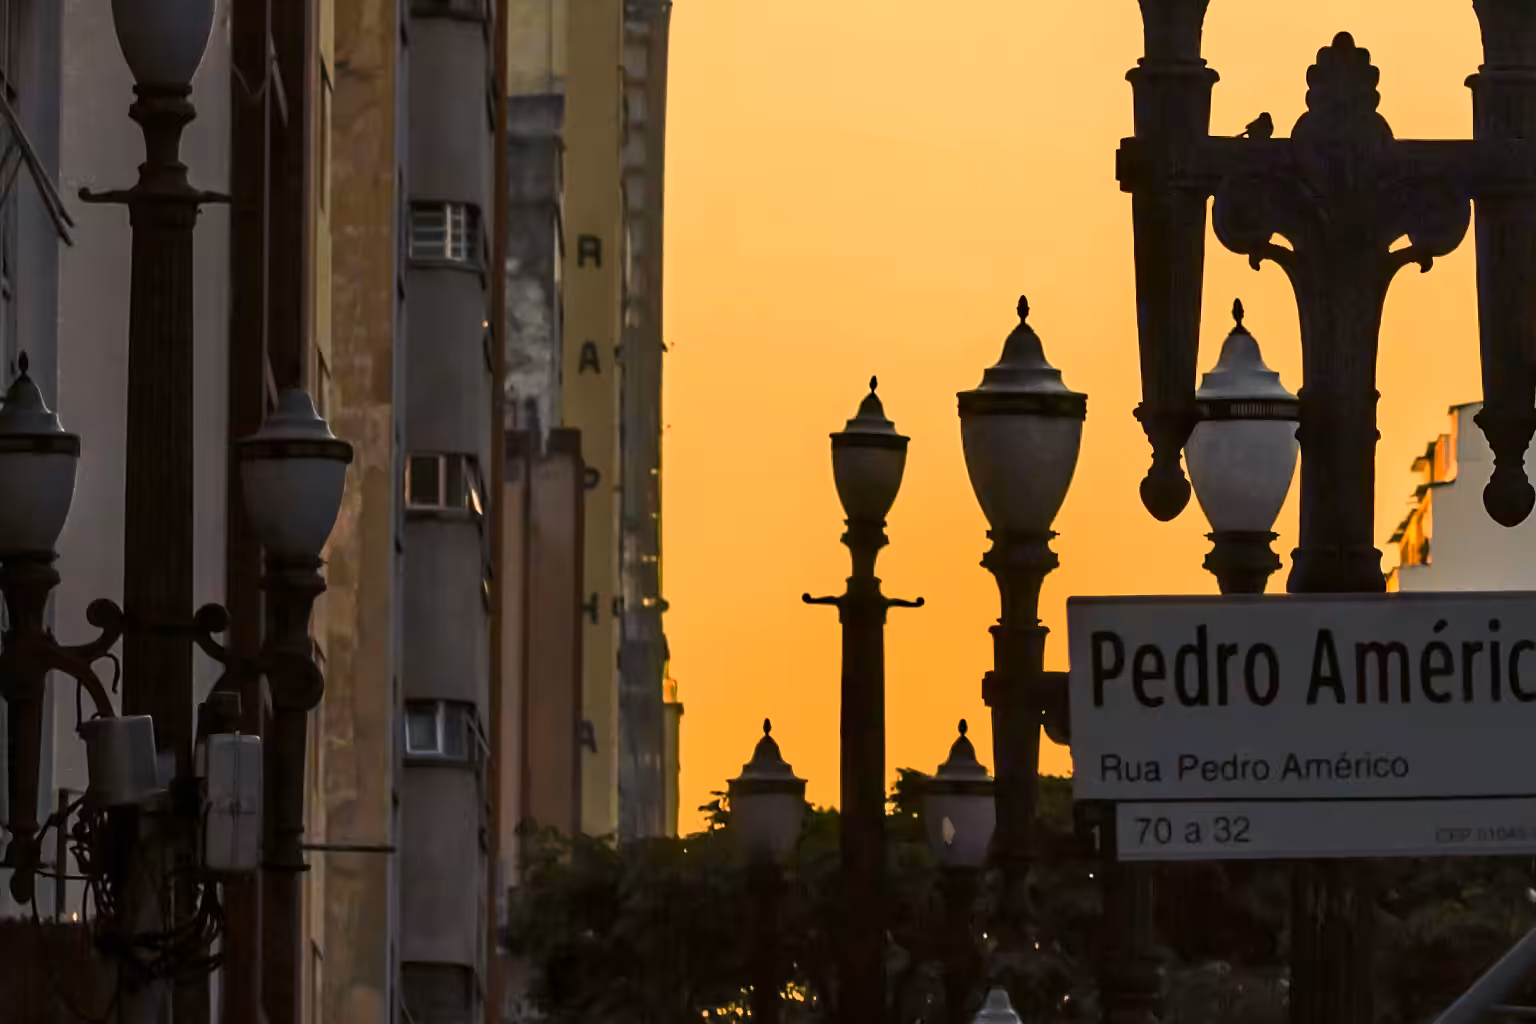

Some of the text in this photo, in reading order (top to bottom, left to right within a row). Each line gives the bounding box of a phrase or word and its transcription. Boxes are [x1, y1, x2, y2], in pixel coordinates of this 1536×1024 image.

[1091, 624, 1280, 708] Pedro
[1100, 752, 1410, 782] Rua Pedro Américo
[1132, 815, 1251, 844] 70 a 32
